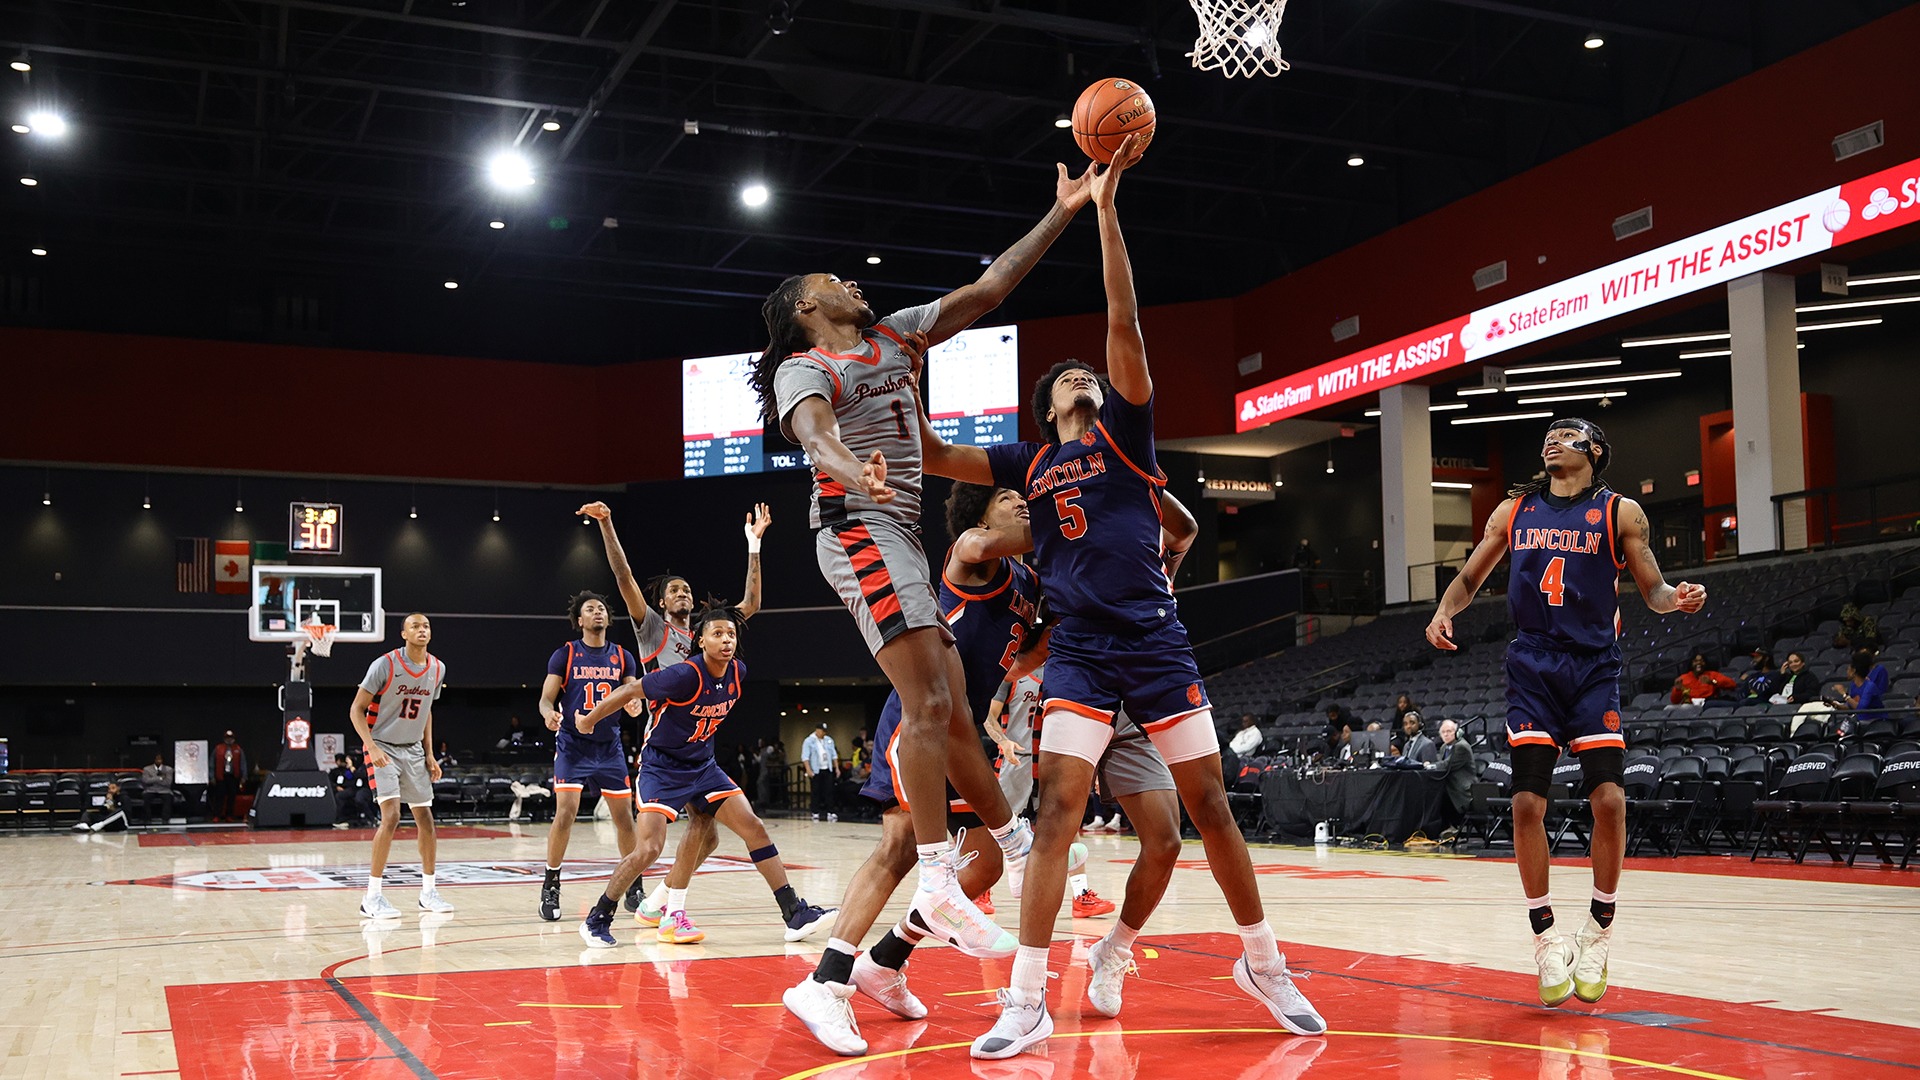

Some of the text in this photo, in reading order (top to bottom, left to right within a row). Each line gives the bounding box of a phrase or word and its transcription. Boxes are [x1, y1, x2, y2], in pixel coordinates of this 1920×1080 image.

[1601, 264, 1660, 305] WITH
[1667, 246, 1714, 284] THE
[1719, 213, 1810, 268] ASSIST
[941, 334, 967, 353] 25
[1317, 365, 1359, 398] WITH
[1360, 353, 1393, 383] THE
[1393, 332, 1454, 374] ASSIST
[890, 398, 911, 440] 1
[771, 455, 797, 468] TOL:
[1053, 486, 1088, 541] 5
[300, 522, 332, 549] 30
[1514, 528, 1602, 554] LINCOLN
[1539, 556, 1566, 607] 4
[573, 666, 622, 682] LINCOLN
[395, 684, 431, 697] Panthers
[583, 681, 612, 711] 13
[398, 698, 421, 719] 15
[686, 717, 725, 743] 15
[1623, 763, 1655, 775] RESERVED
[1786, 761, 1827, 774] RESERVED
[267, 784, 326, 798] Aaron's
